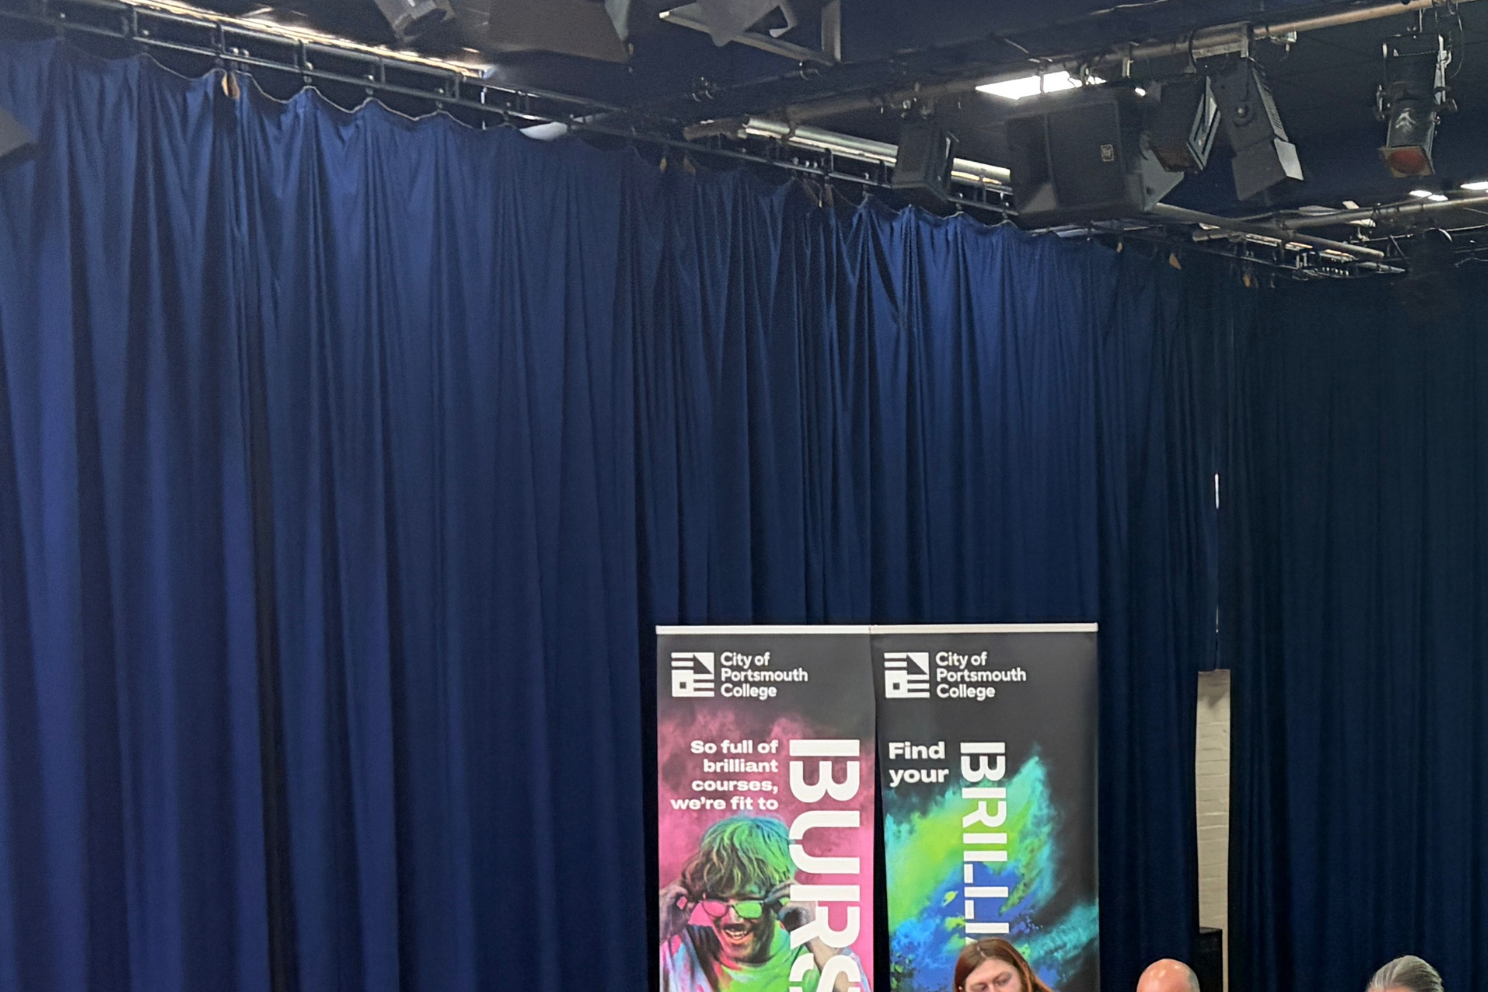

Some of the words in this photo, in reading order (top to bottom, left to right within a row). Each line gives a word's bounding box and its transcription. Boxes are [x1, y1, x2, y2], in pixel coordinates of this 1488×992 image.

[720, 651, 752, 669] City
[754, 651, 770, 666] of
[935, 651, 969, 669] City
[970, 651, 988, 666] of
[720, 667, 808, 682] Portsmouth
[936, 667, 1026, 682] Portsmouth
[720, 683, 777, 700] College
[936, 684, 996, 702] College
[690, 740, 717, 754] So
[721, 740, 753, 754] full
[757, 740, 779, 754] of
[888, 741, 946, 760] Find
[703, 758, 778, 773] brilliant
[889, 768, 950, 788] your
[691, 780, 778, 794] courses,
[671, 798, 726, 810] we're
[730, 796, 753, 810] fit
[758, 797, 778, 810] to
[960, 742, 1010, 946] BRILLI
